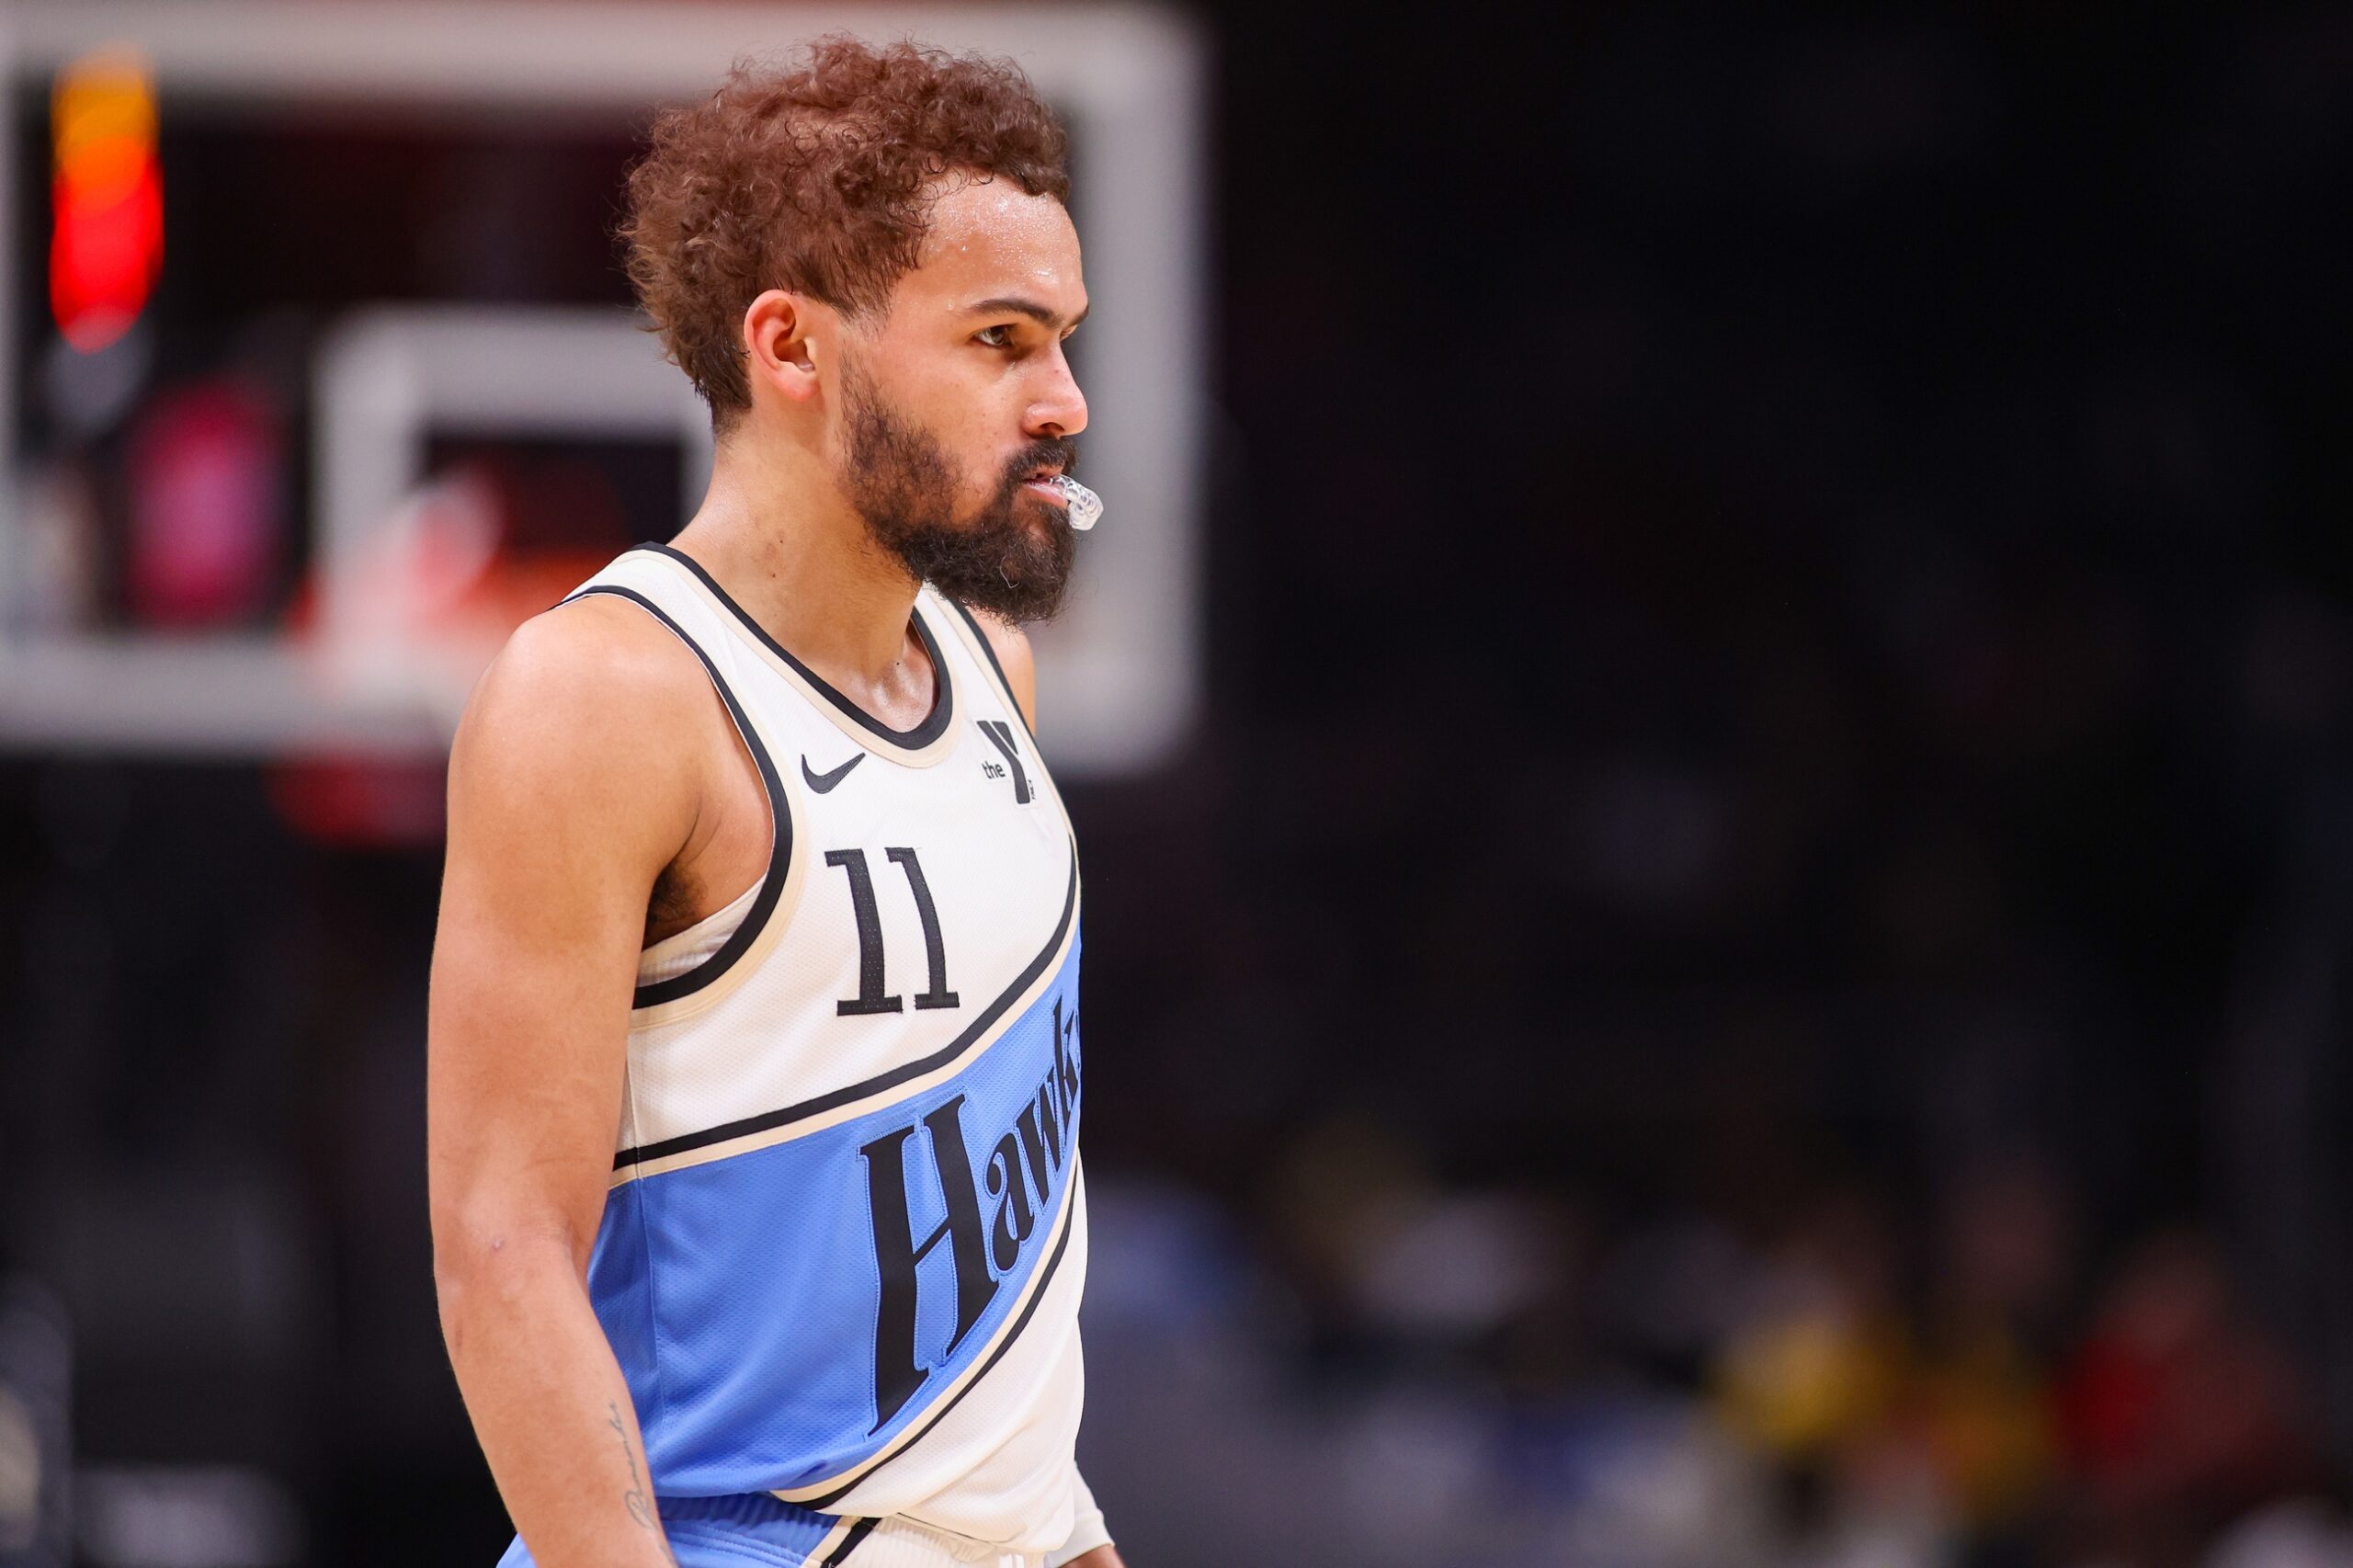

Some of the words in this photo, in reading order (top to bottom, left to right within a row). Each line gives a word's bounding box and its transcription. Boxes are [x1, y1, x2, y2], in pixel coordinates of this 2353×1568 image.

[976, 720, 1030, 805] Y
[981, 760, 1006, 779] the
[824, 847, 960, 1017] 11
[858, 994, 1081, 1437] Hawk
